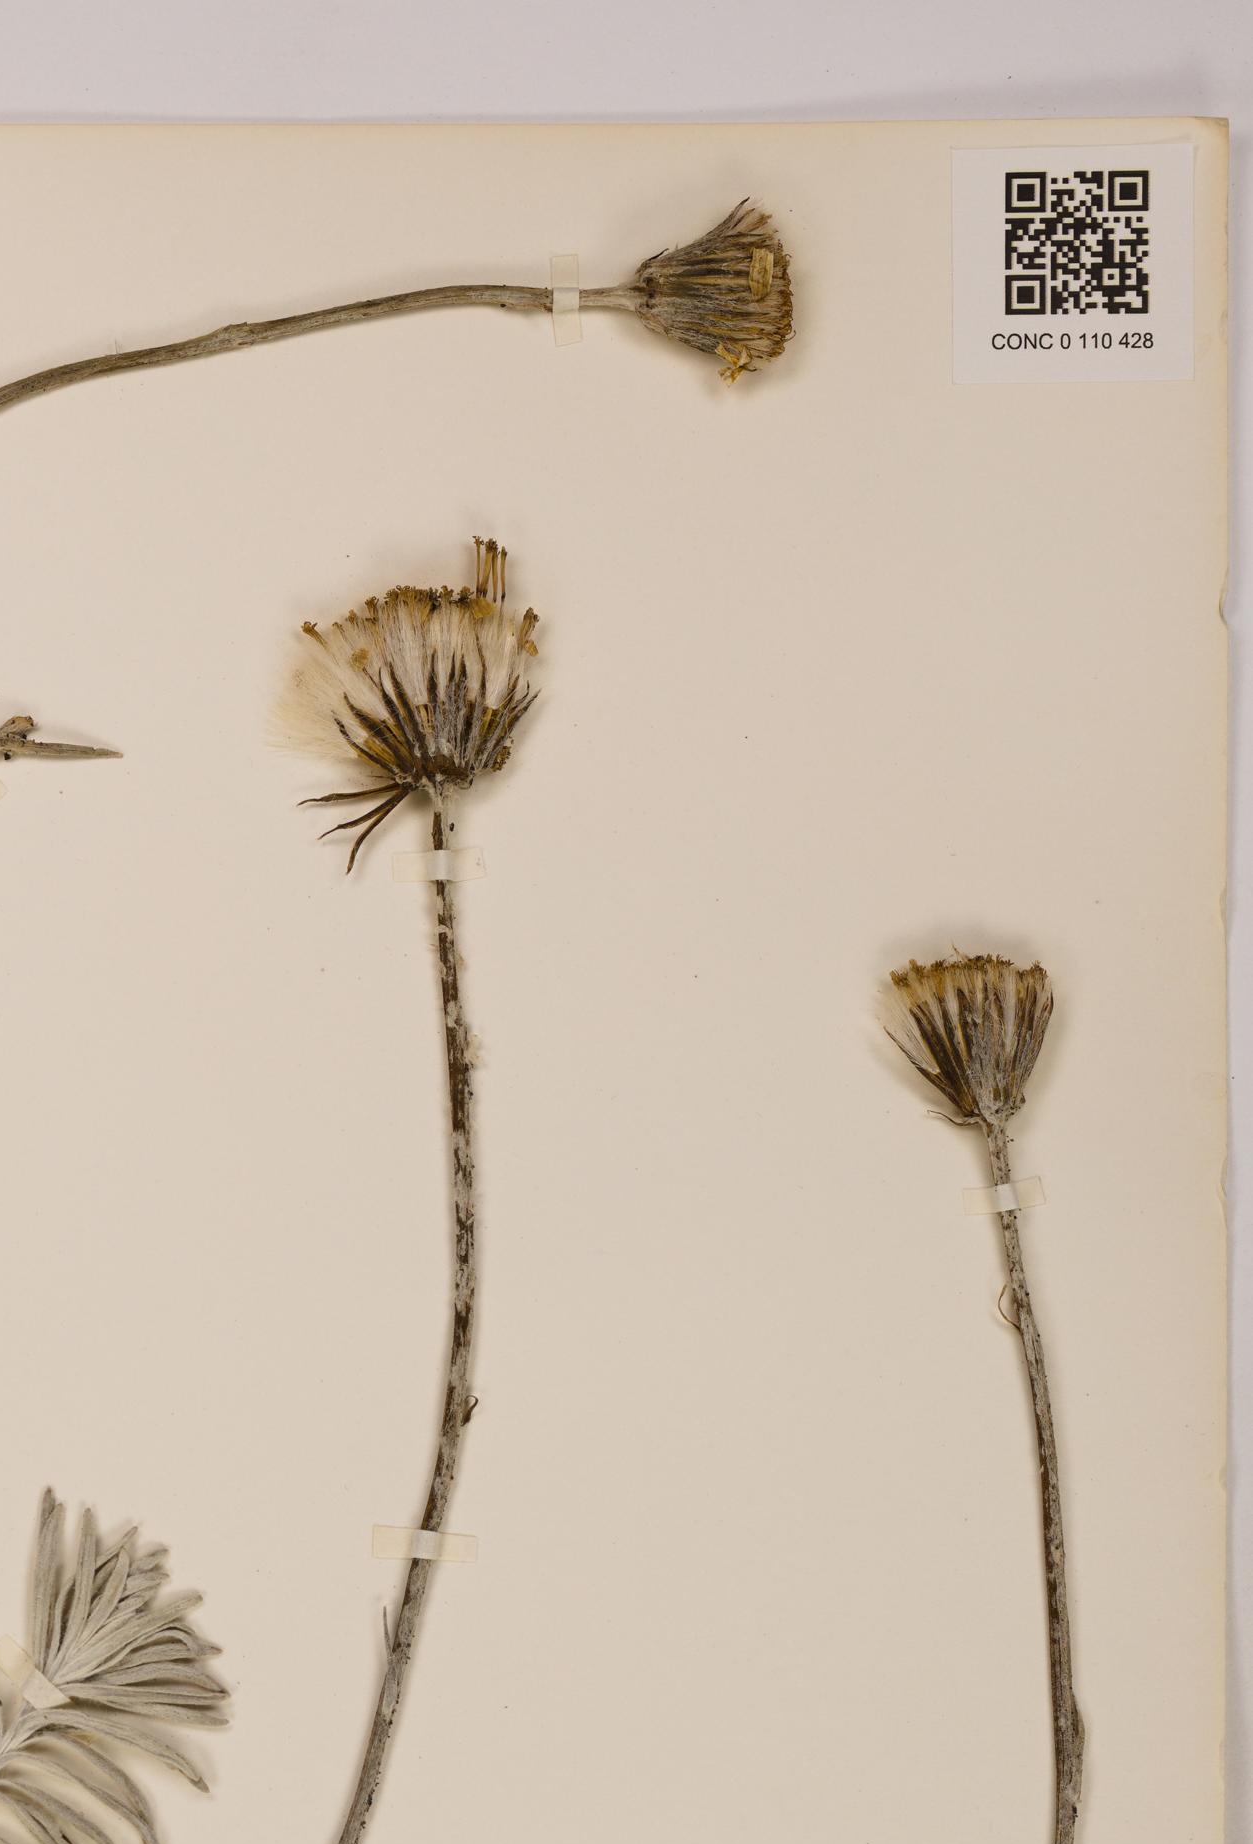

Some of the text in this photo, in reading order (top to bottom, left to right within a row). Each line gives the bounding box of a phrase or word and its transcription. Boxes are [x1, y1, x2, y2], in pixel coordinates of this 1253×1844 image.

[991, 331, 1155, 351] CONC 0 110 428
